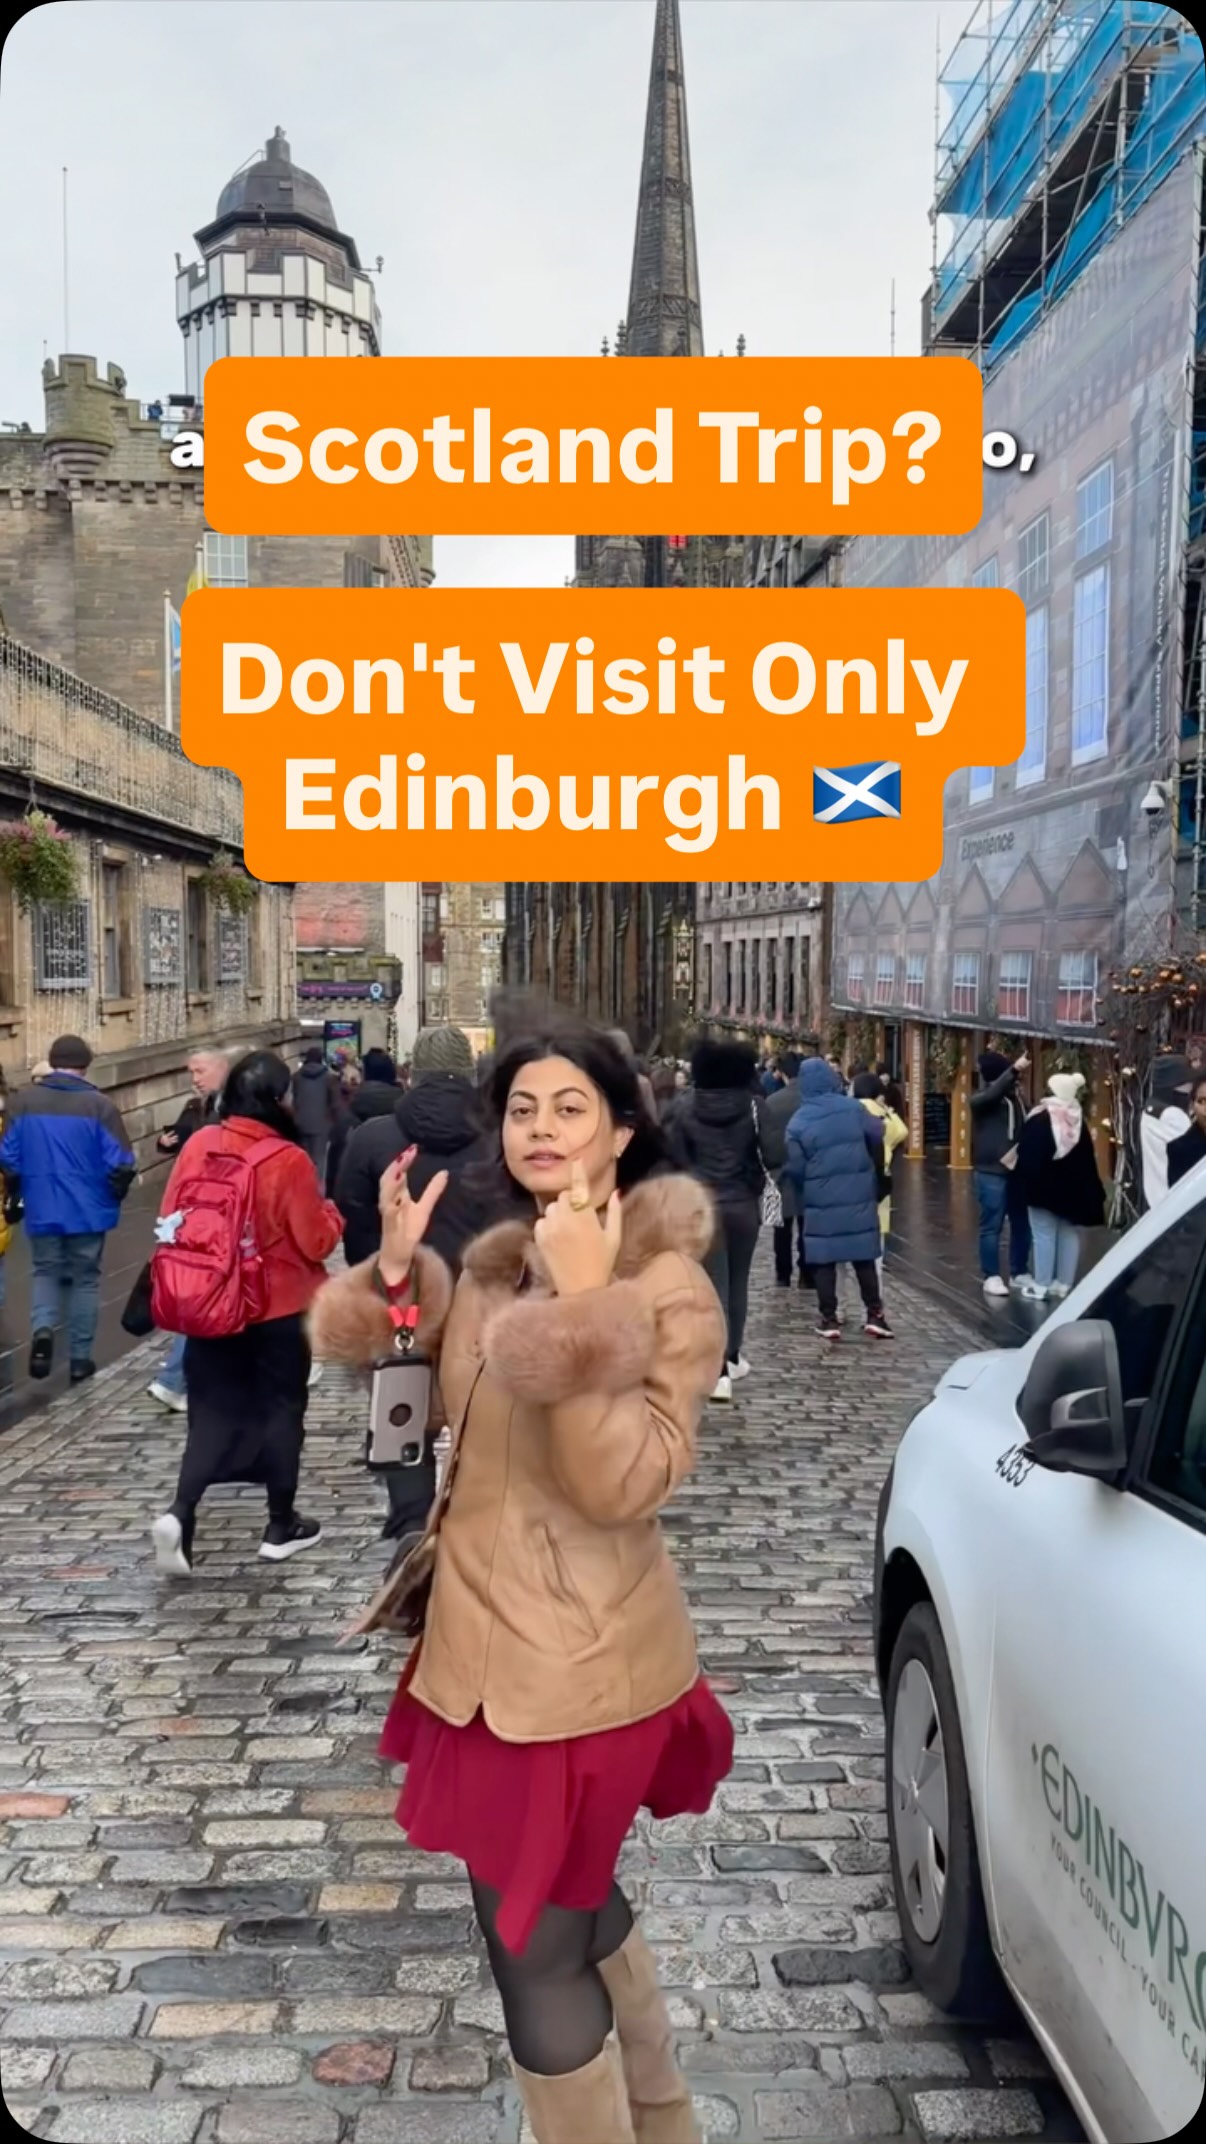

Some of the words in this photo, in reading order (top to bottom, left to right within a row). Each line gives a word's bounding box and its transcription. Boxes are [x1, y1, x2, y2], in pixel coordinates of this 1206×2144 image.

[961, 831, 1015, 862] Experience
[1051, 1832, 1076, 1884] YOUR
[1080, 1876, 1127, 1963] COUNCIL
[1139, 1965, 1175, 2038] YOUR
